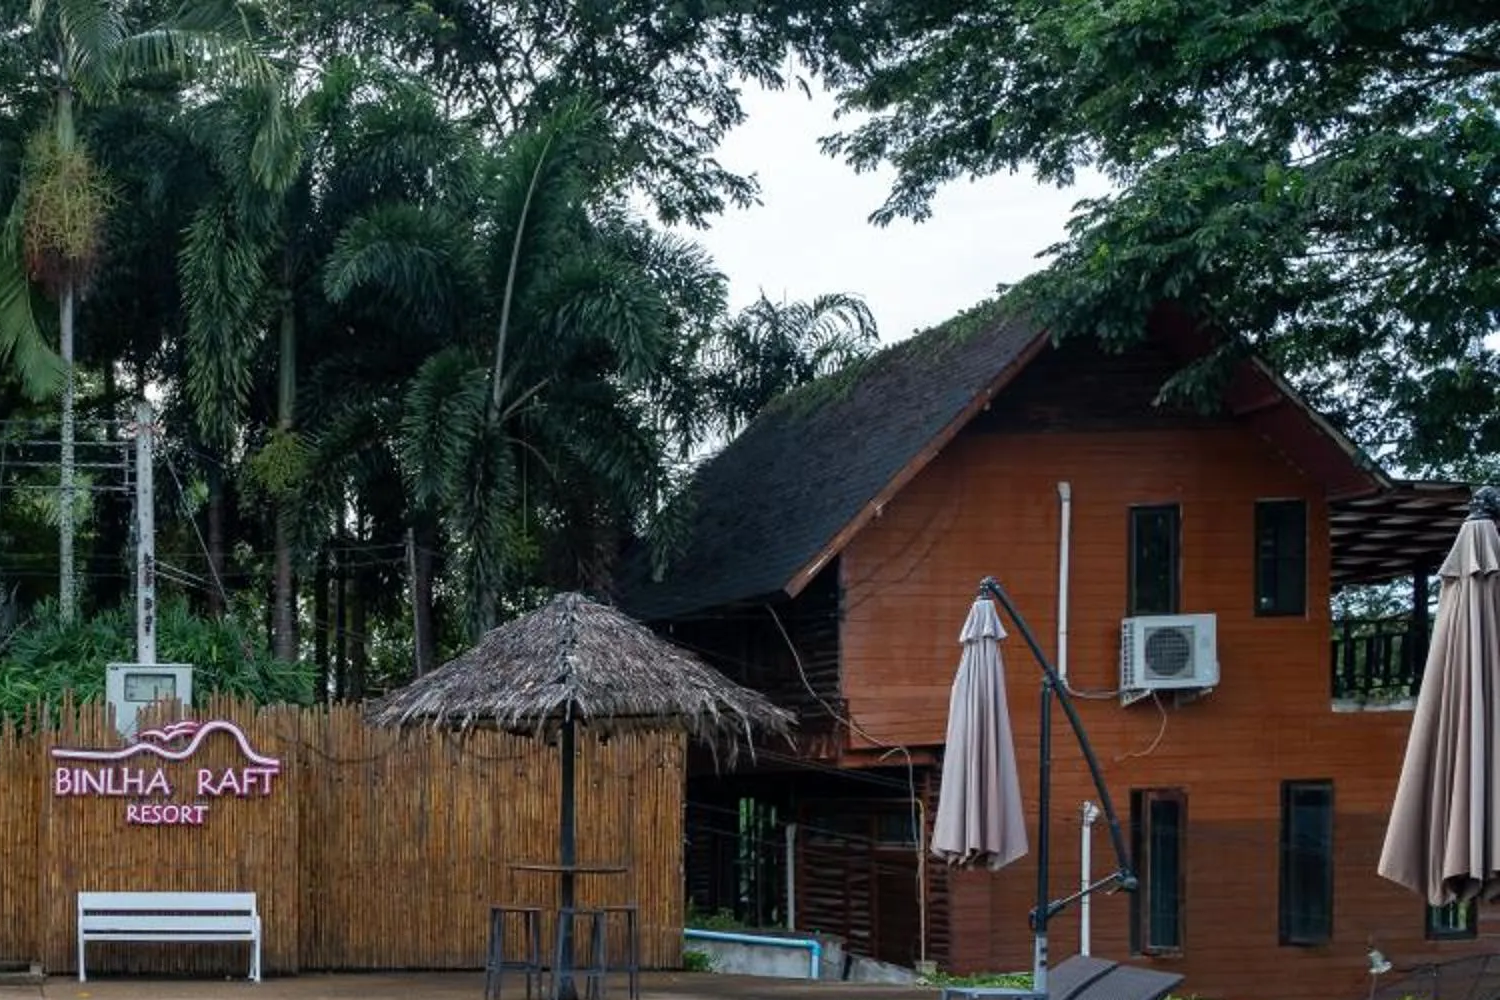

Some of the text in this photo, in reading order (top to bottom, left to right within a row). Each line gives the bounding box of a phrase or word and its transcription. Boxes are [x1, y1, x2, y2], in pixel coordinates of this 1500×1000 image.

[55, 767, 280, 796] BINLHA RAFT
[126, 805, 209, 824] RESORT
